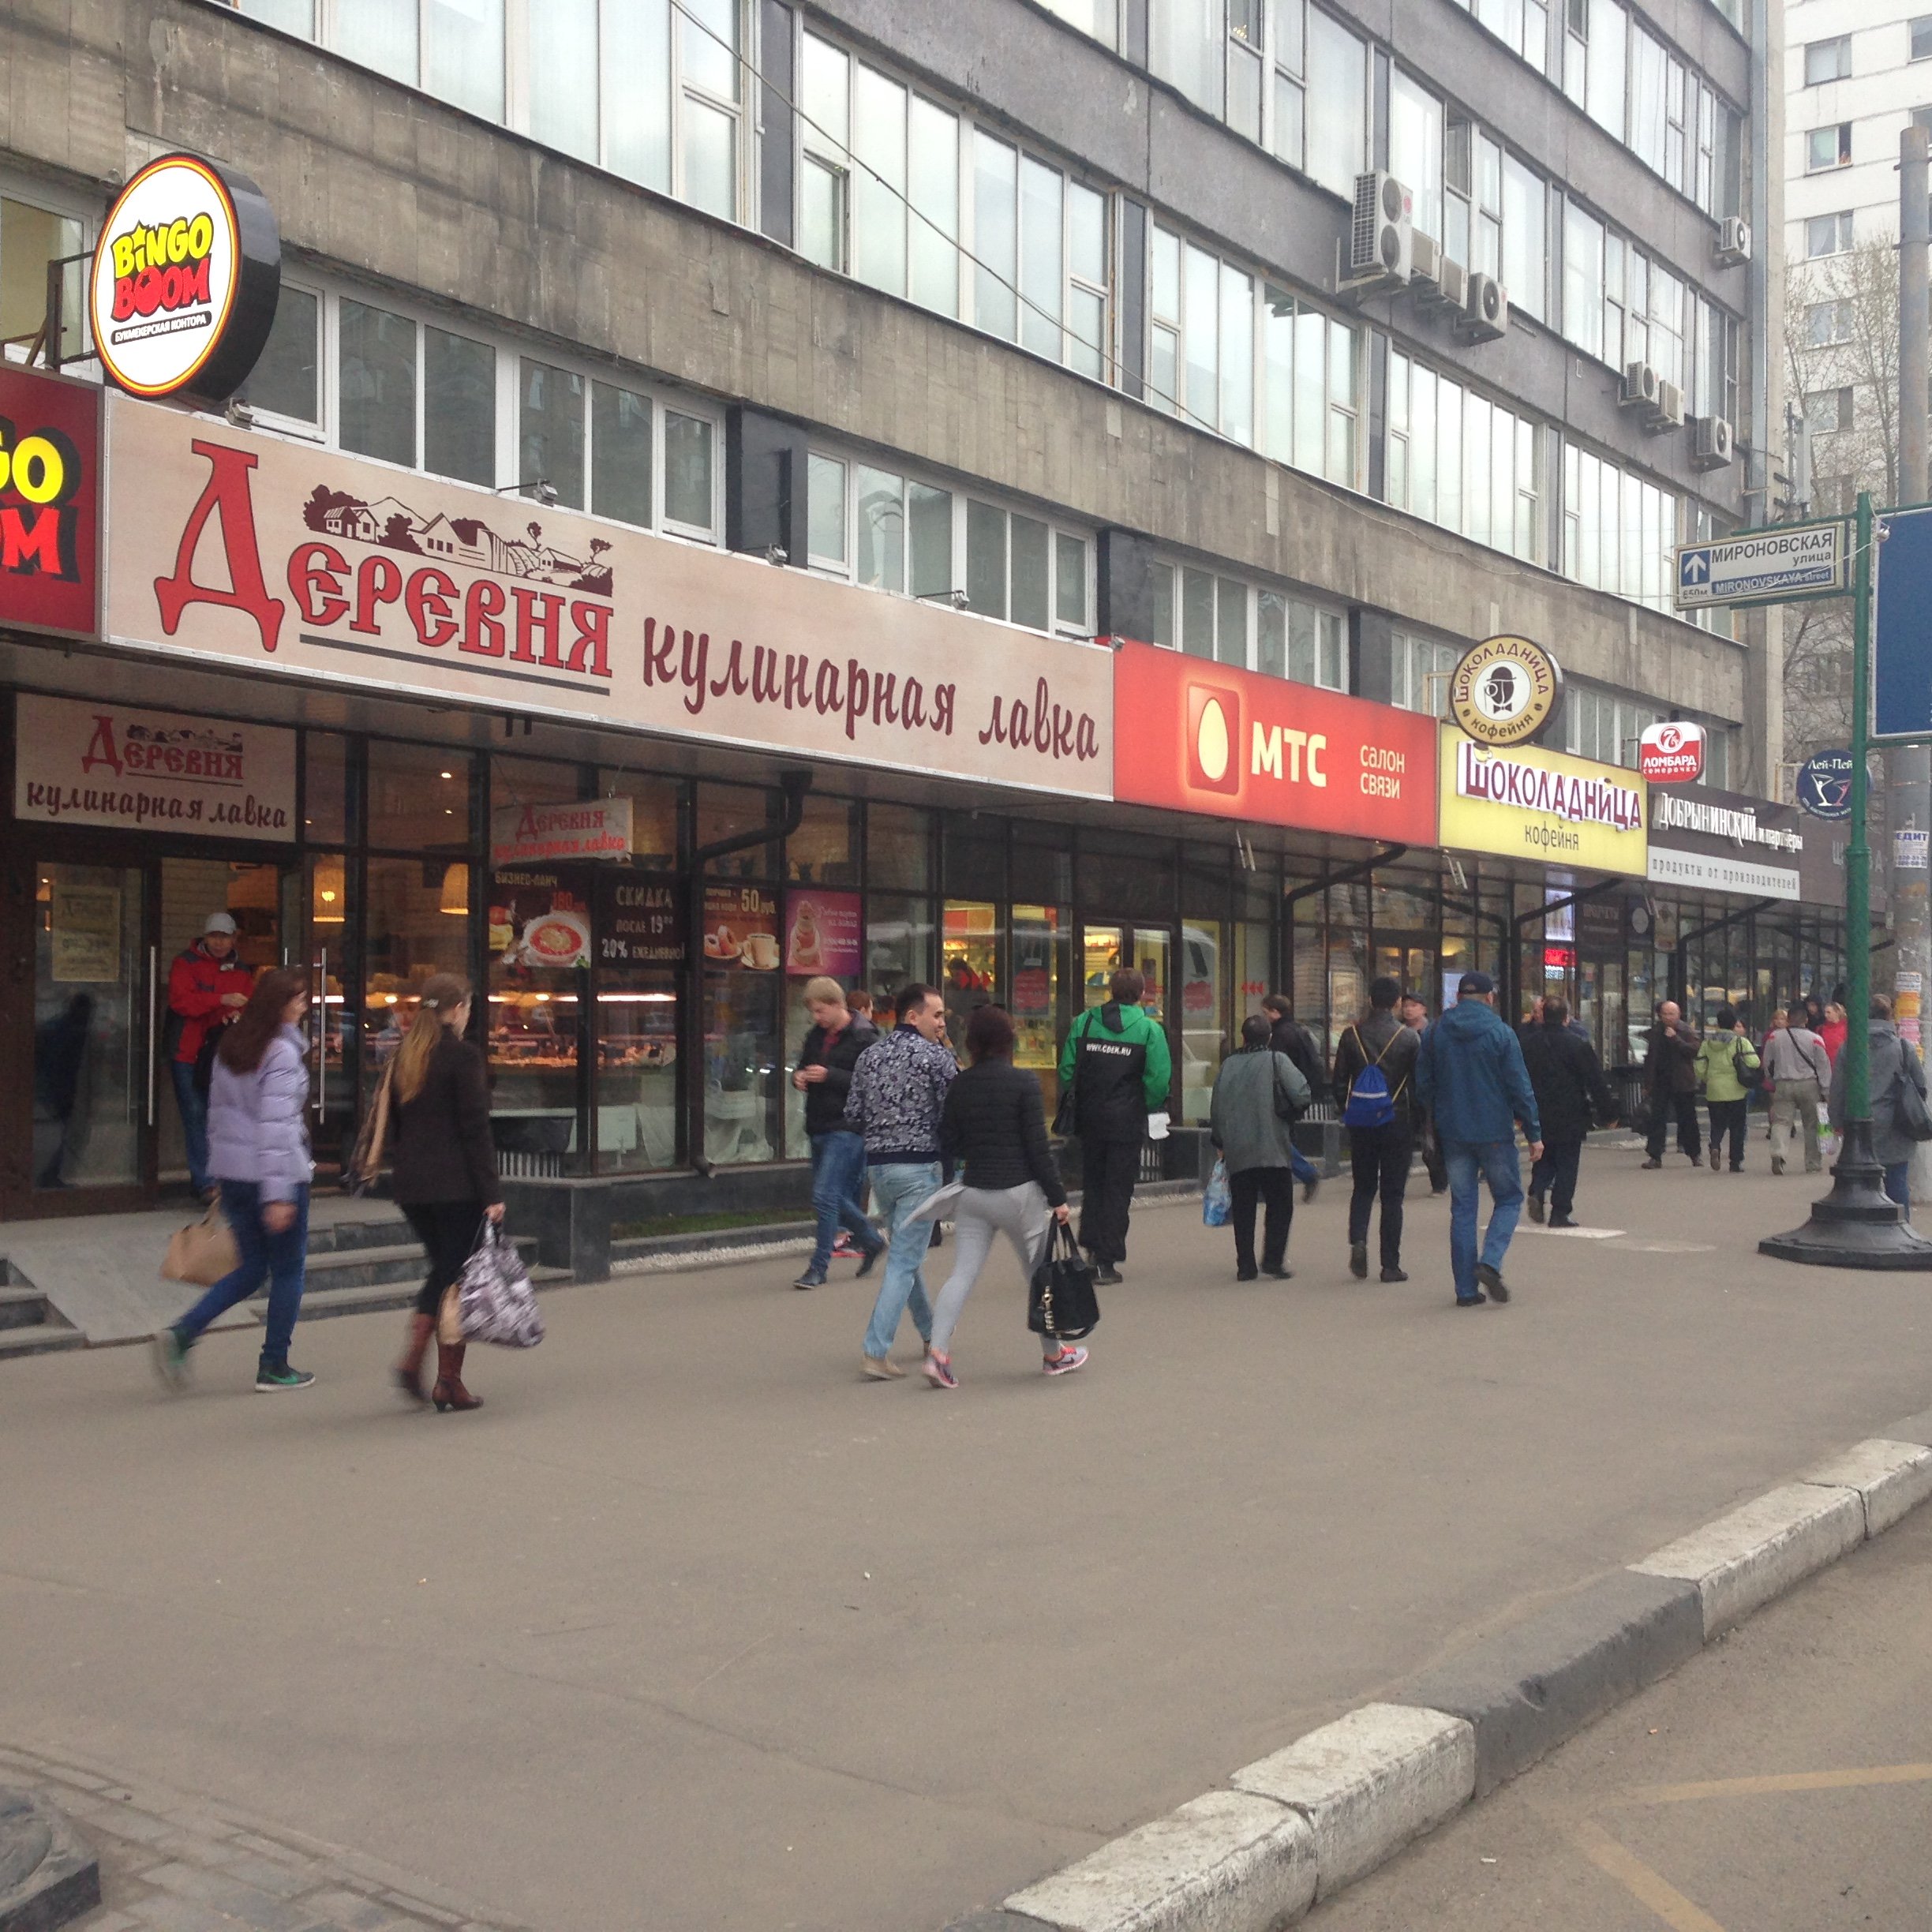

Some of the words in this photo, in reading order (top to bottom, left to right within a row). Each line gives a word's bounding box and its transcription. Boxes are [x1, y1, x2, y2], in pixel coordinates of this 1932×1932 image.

[111, 256, 211, 321] BOOM
[114, 320, 170, 342] БУКМЕКЕРСКАЯ
[170, 313, 207, 331] КОНТОРА
[1711, 533, 1833, 564] МИРОНОВСКАЯ
[1792, 552, 1832, 567] улица
[1716, 571, 1802, 594] MIRONOVSKAYA
[1804, 571, 1830, 582] street
[1455, 643, 1549, 703] ШОКОЛАДНИЦА
[643, 616, 957, 740] кулинарная
[979, 676, 1099, 762] лавка
[1470, 713, 1534, 740] кофейня
[1251, 721, 1327, 787] МТС
[1360, 744, 1406, 773] салон
[1643, 755, 1697, 768] ЛОМБАРД
[1808, 758, 1852, 769] Лей-Пей
[1360, 773, 1400, 799] связи
[1466, 743, 1642, 830] ШОКОЛАДНИЦА
[27, 781, 203, 823] кулинарная
[209, 794, 288, 829] лавка
[1657, 792, 1756, 848] ДОБРЫНИНСКИЙ
[1525, 821, 1579, 853] кофейня
[1653, 858, 1702, 877] продукты
[1709, 867, 1718, 879] от
[1724, 869, 1796, 890] производителей
[616, 886, 673, 909] СКИДКА
[741, 888, 760, 912] 50
[601, 938, 628, 959] 20%
